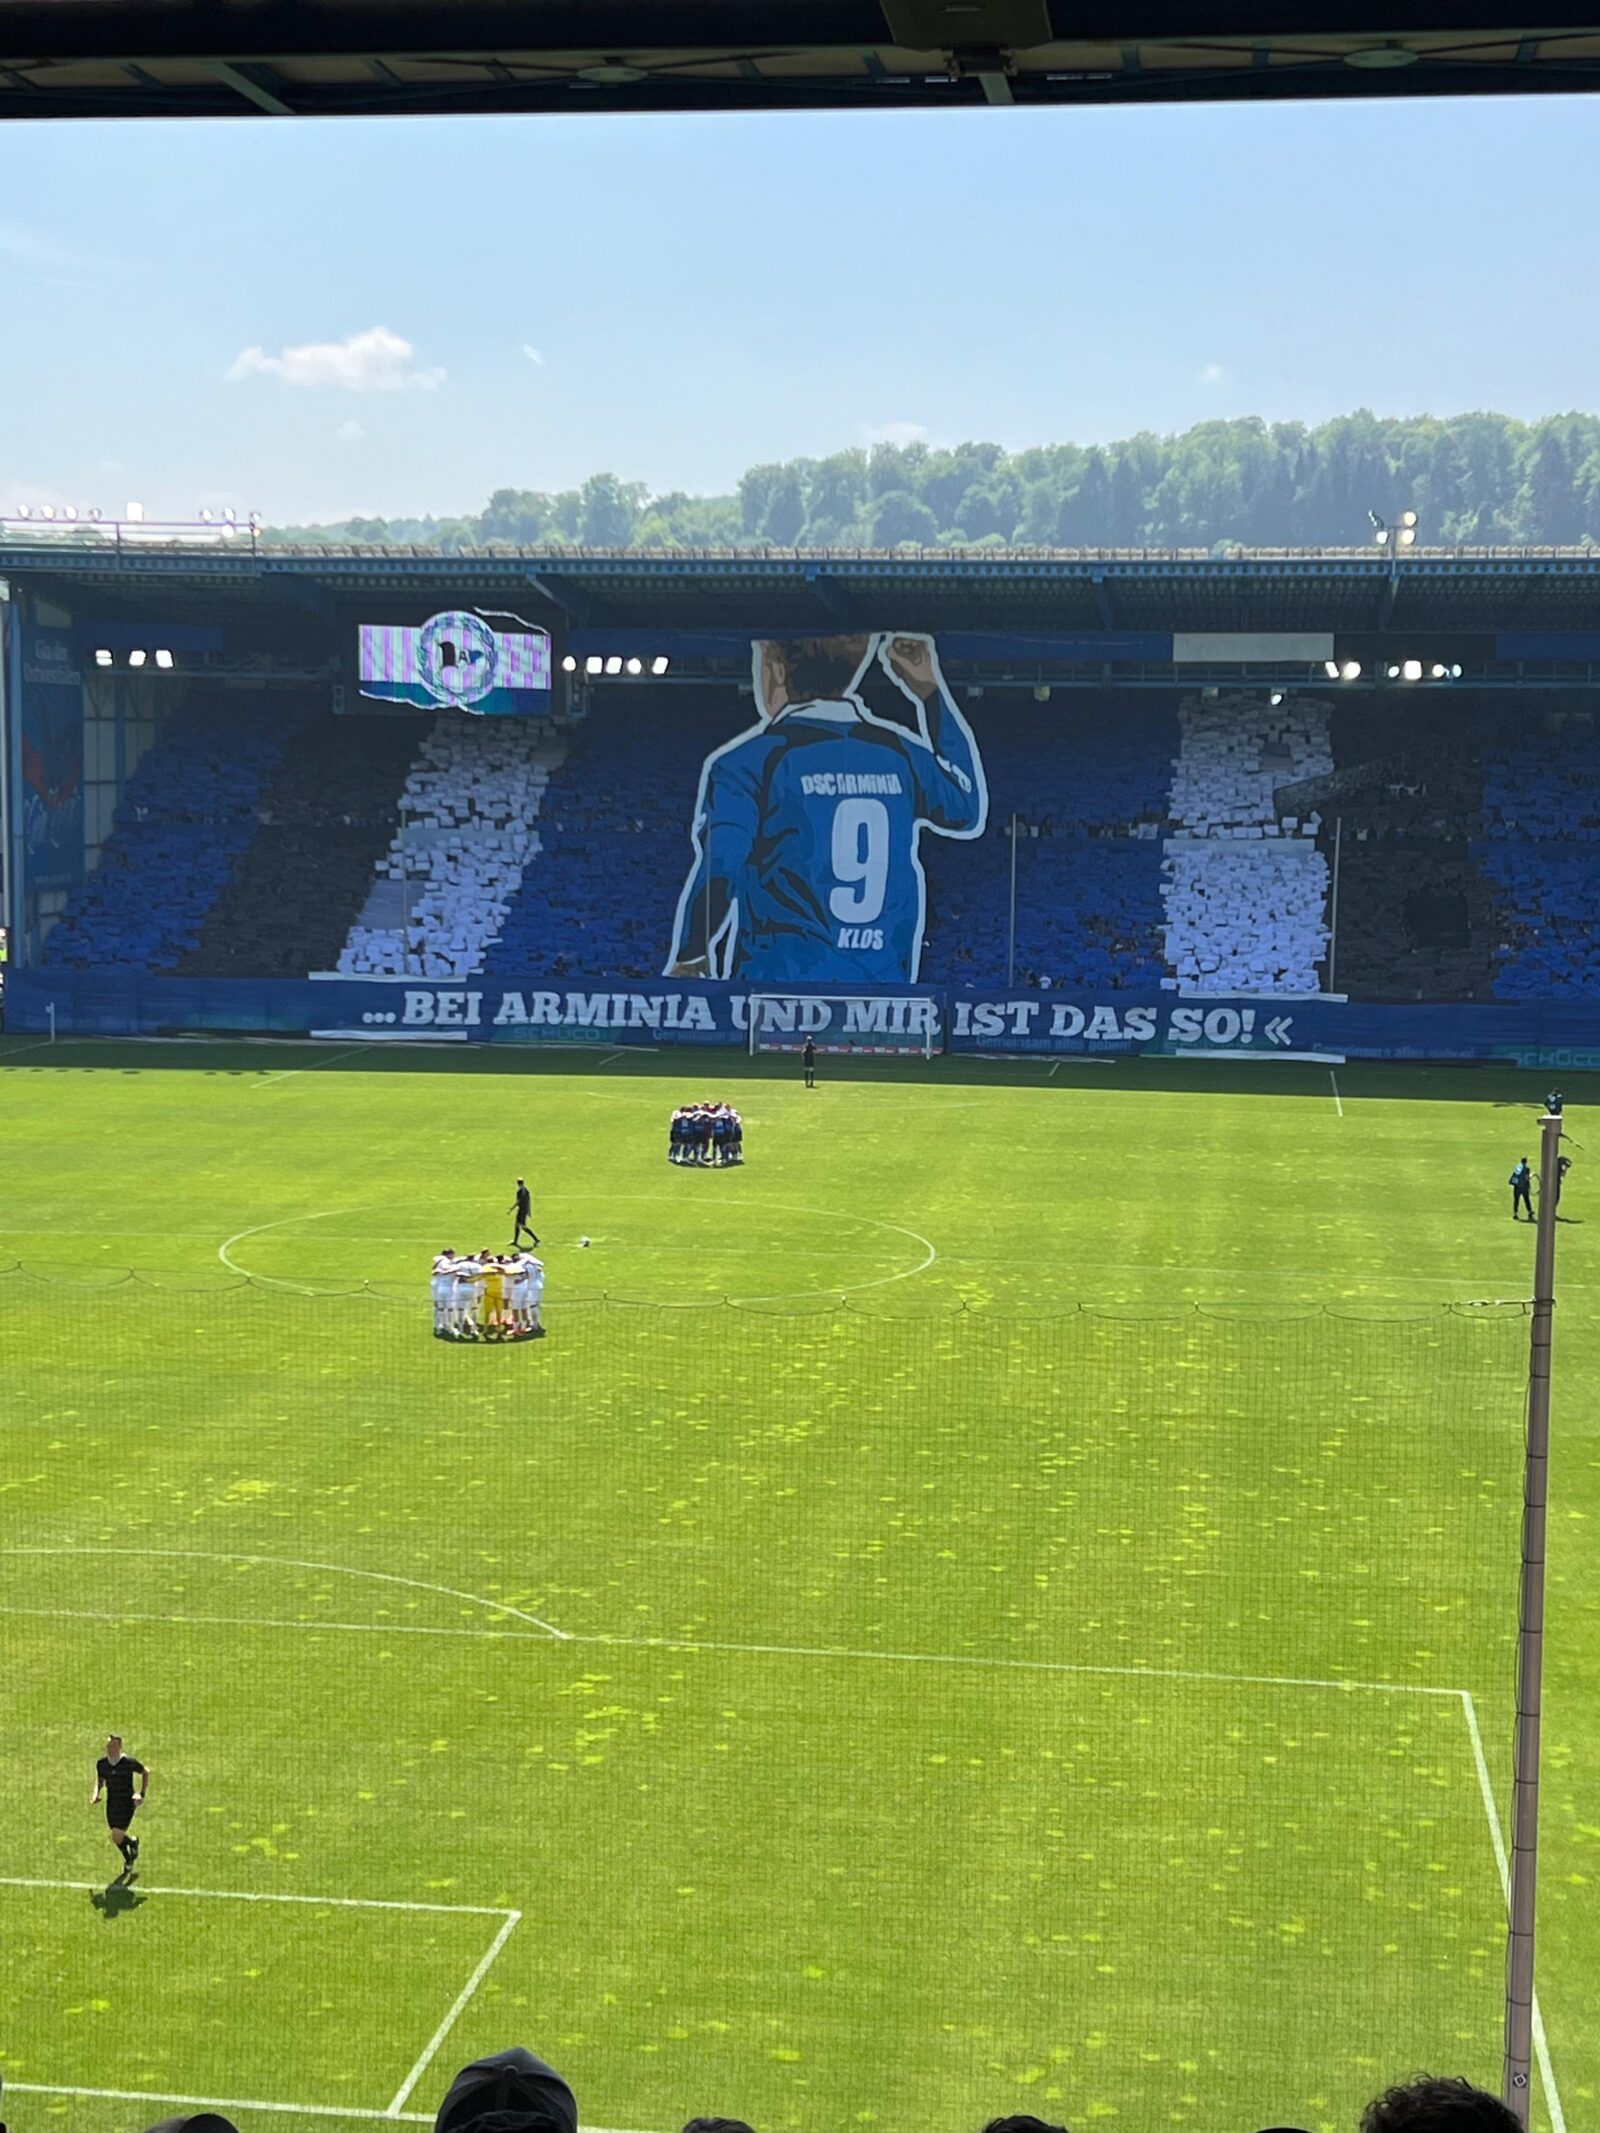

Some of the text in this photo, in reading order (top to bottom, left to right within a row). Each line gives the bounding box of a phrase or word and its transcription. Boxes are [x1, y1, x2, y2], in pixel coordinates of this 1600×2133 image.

[830, 798, 889, 923] 9
[837, 928, 884, 950] KLOS
[493, 990, 716, 1031] ARMINIA
[729, 995, 832, 1032] UND
[842, 1000, 941, 1035] MIR
[952, 1001, 1040, 1036] IST
[1049, 1003, 1157, 1041] DAS
[1168, 1007, 1256, 1044] SO!
